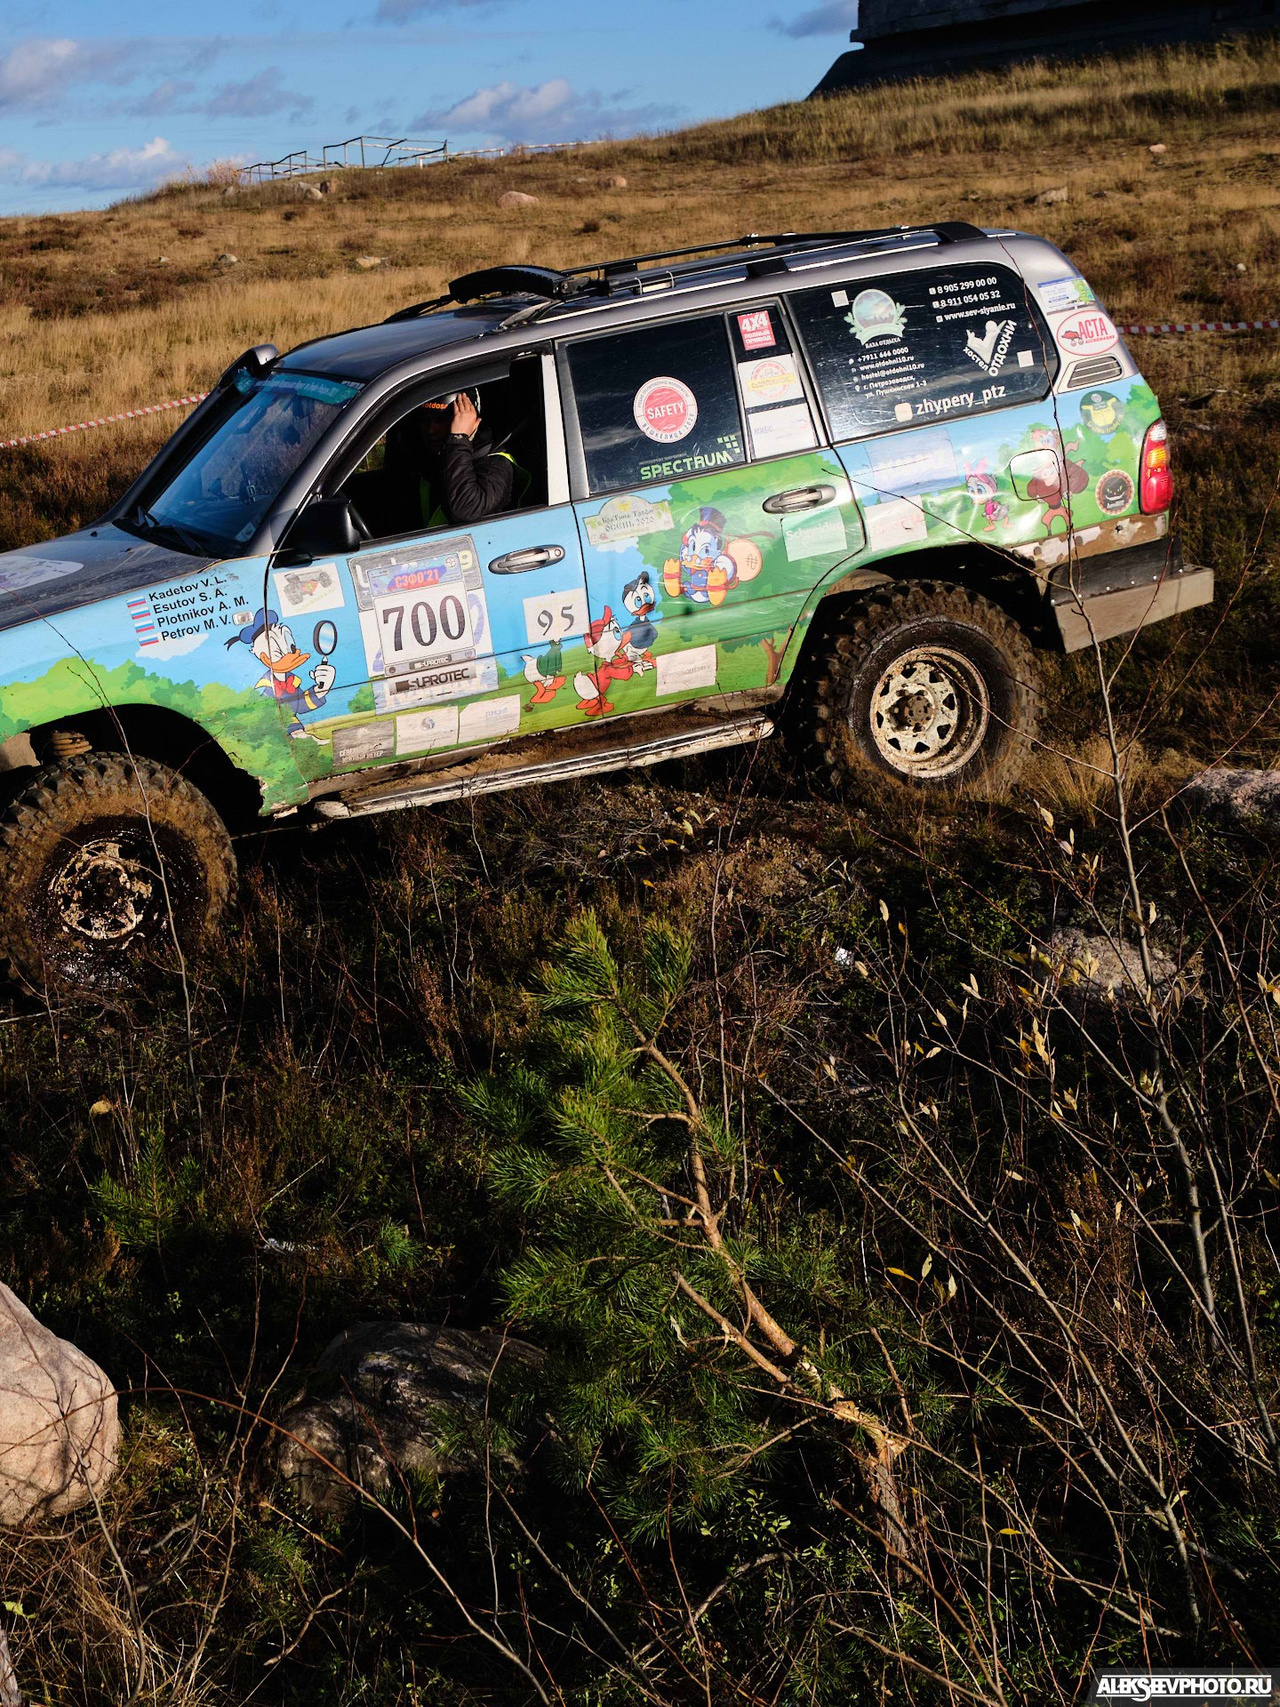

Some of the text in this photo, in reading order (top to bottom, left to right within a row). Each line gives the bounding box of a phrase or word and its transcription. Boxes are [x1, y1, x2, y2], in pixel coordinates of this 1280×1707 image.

[937, 276, 997, 294] 8 905 299 00 00
[940, 290, 1001, 307] 8 911 054 05 32
[944, 302, 1016, 321] www.sev-siyanie.ru
[858, 346, 909, 363] +7911 666 0000
[988, 319, 1017, 377] ОТДОХНИ
[859, 355, 914, 371] www.otdohni10.ru
[861, 363, 925, 380] hostel@otdohni10.ru
[646, 401, 685, 419] SAFETY
[916, 384, 1007, 416] zhypery_ptz
[640, 450, 734, 480] SPECTRUM
[148, 576, 227, 601] Kadetov V. L.
[153, 588, 228, 614] Esutov S. A.
[157, 595, 249, 628] Plotnikov A. M.
[382, 595, 466, 652] 700
[537, 604, 575, 636] 95
[161, 614, 231, 641] Petrov M. V.
[407, 667, 470, 688] SUPROTEC
